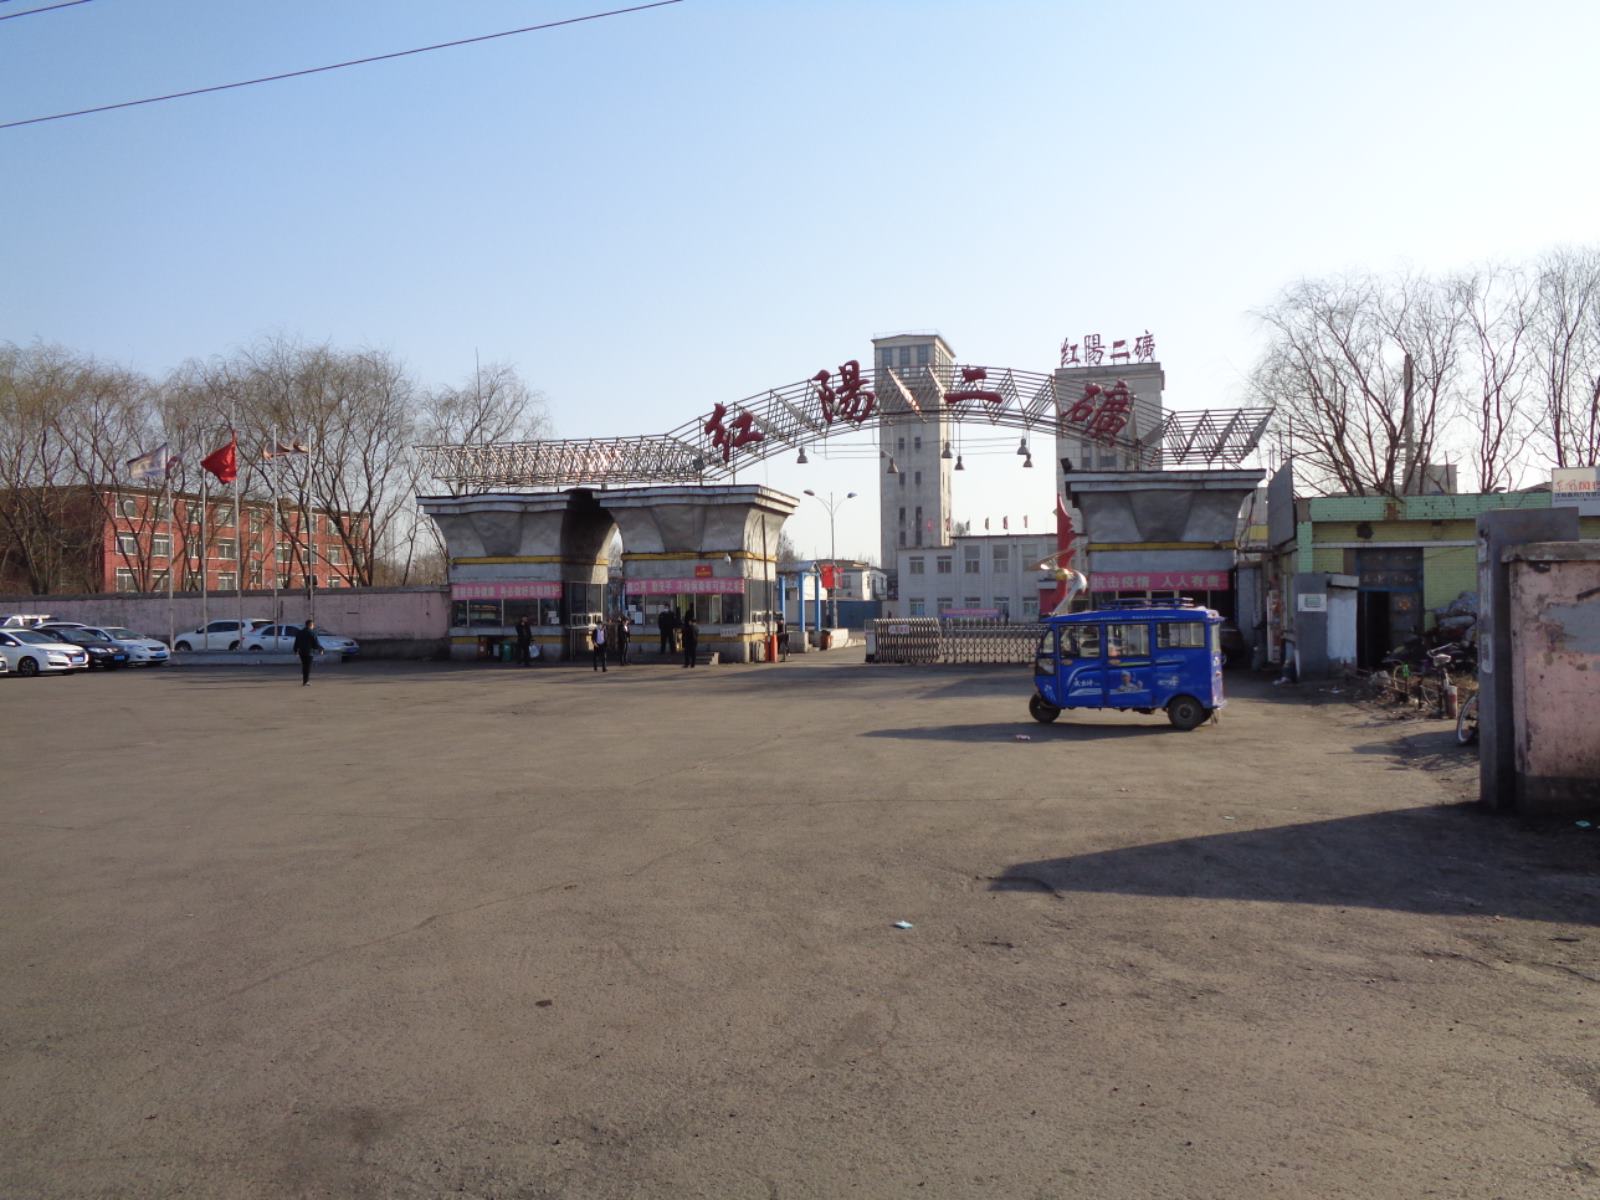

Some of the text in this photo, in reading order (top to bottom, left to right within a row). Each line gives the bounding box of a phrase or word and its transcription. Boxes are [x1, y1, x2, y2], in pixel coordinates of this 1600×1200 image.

[1090, 573, 1220, 591] 抗击疫情 人人有责
